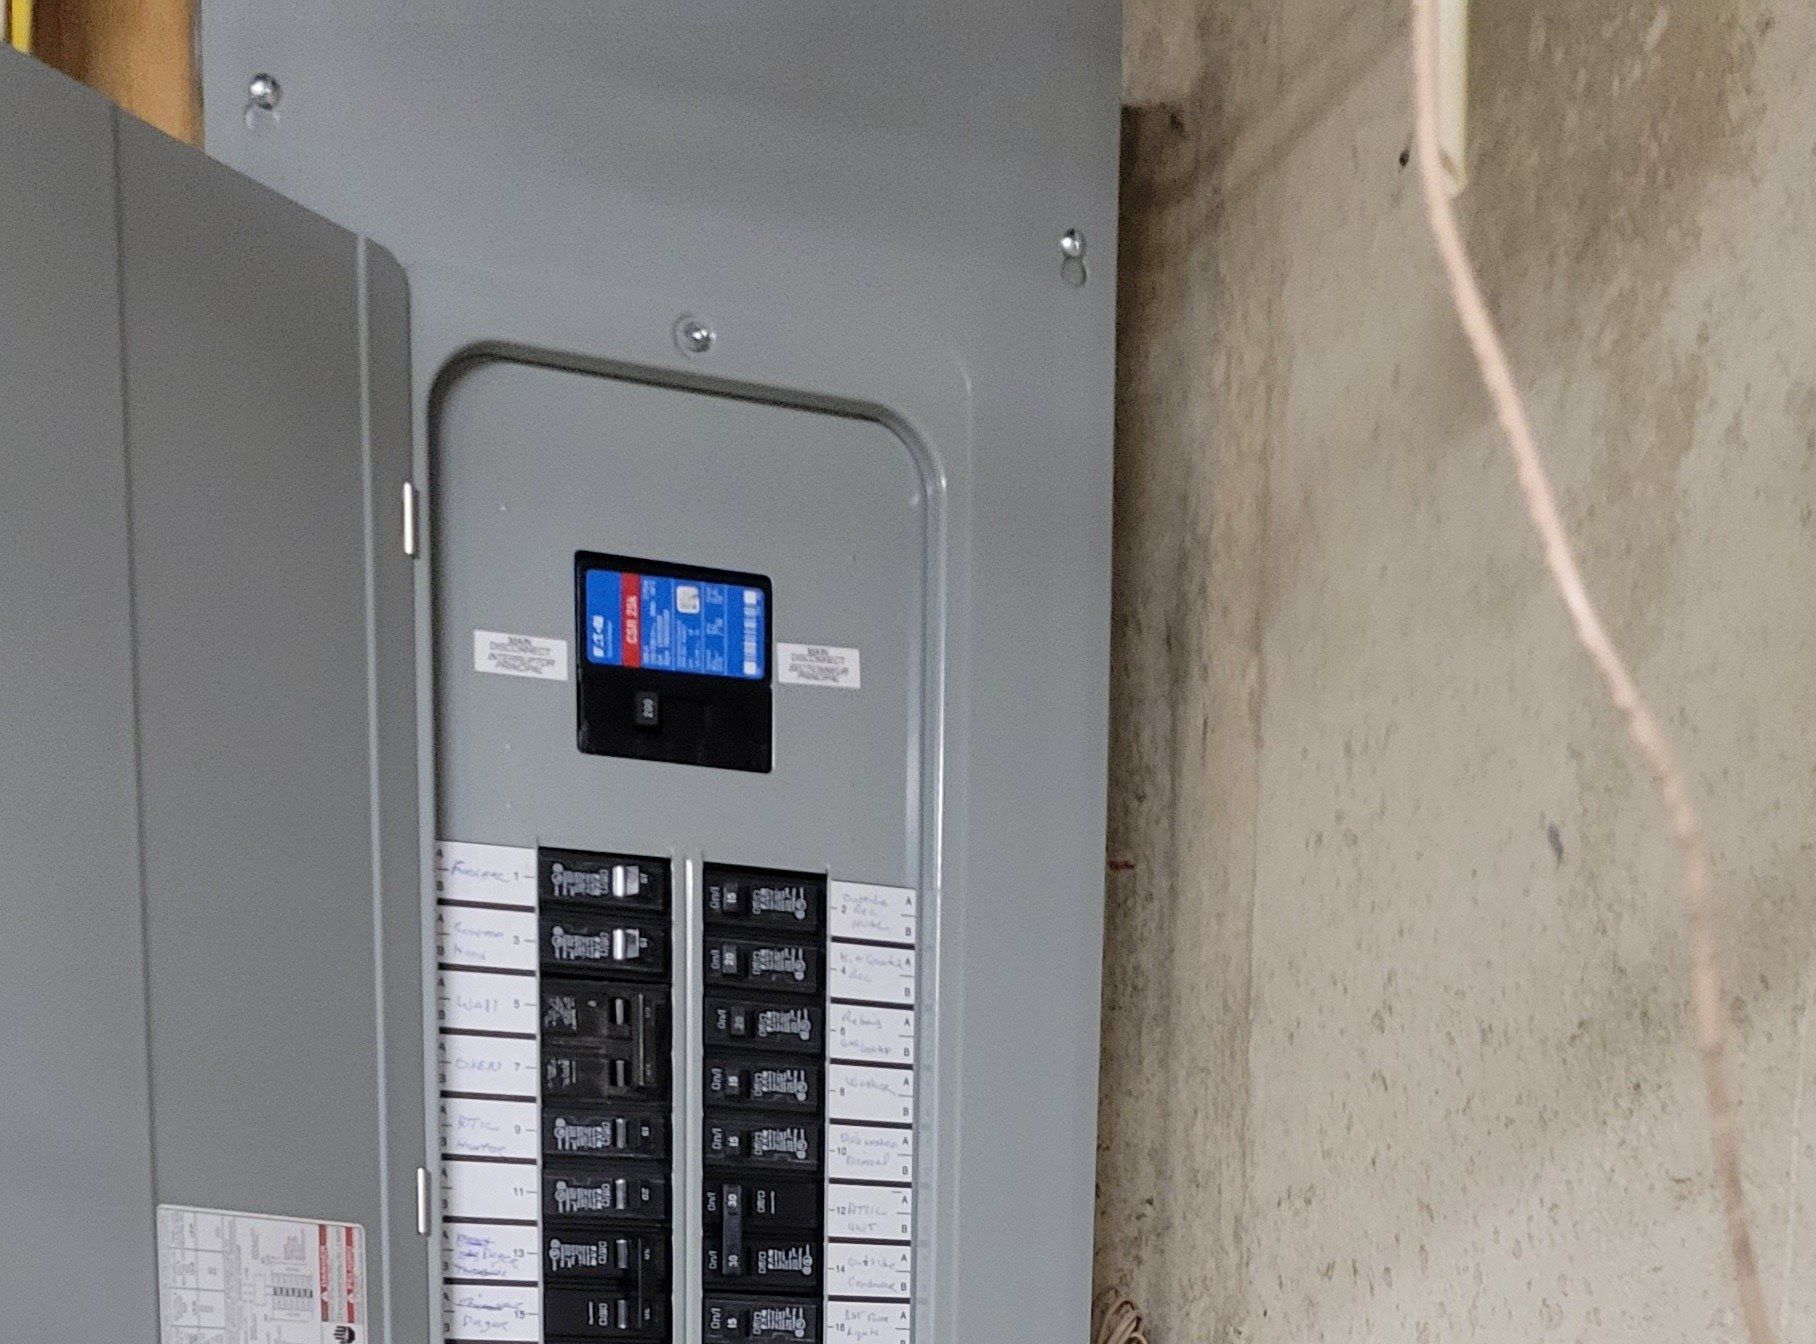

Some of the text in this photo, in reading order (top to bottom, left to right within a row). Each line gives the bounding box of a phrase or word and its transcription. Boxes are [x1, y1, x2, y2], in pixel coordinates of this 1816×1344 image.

[514, 1062, 520, 1071] 7
[837, 1146, 847, 1156] 10
[902, 1166, 908, 1175] B
[513, 1187, 523, 1196] 11
[836, 1206, 846, 1215] 12
[836, 1265, 846, 1273] 14
[515, 1310, 525, 1319] 15
[900, 1311, 907, 1320] A
